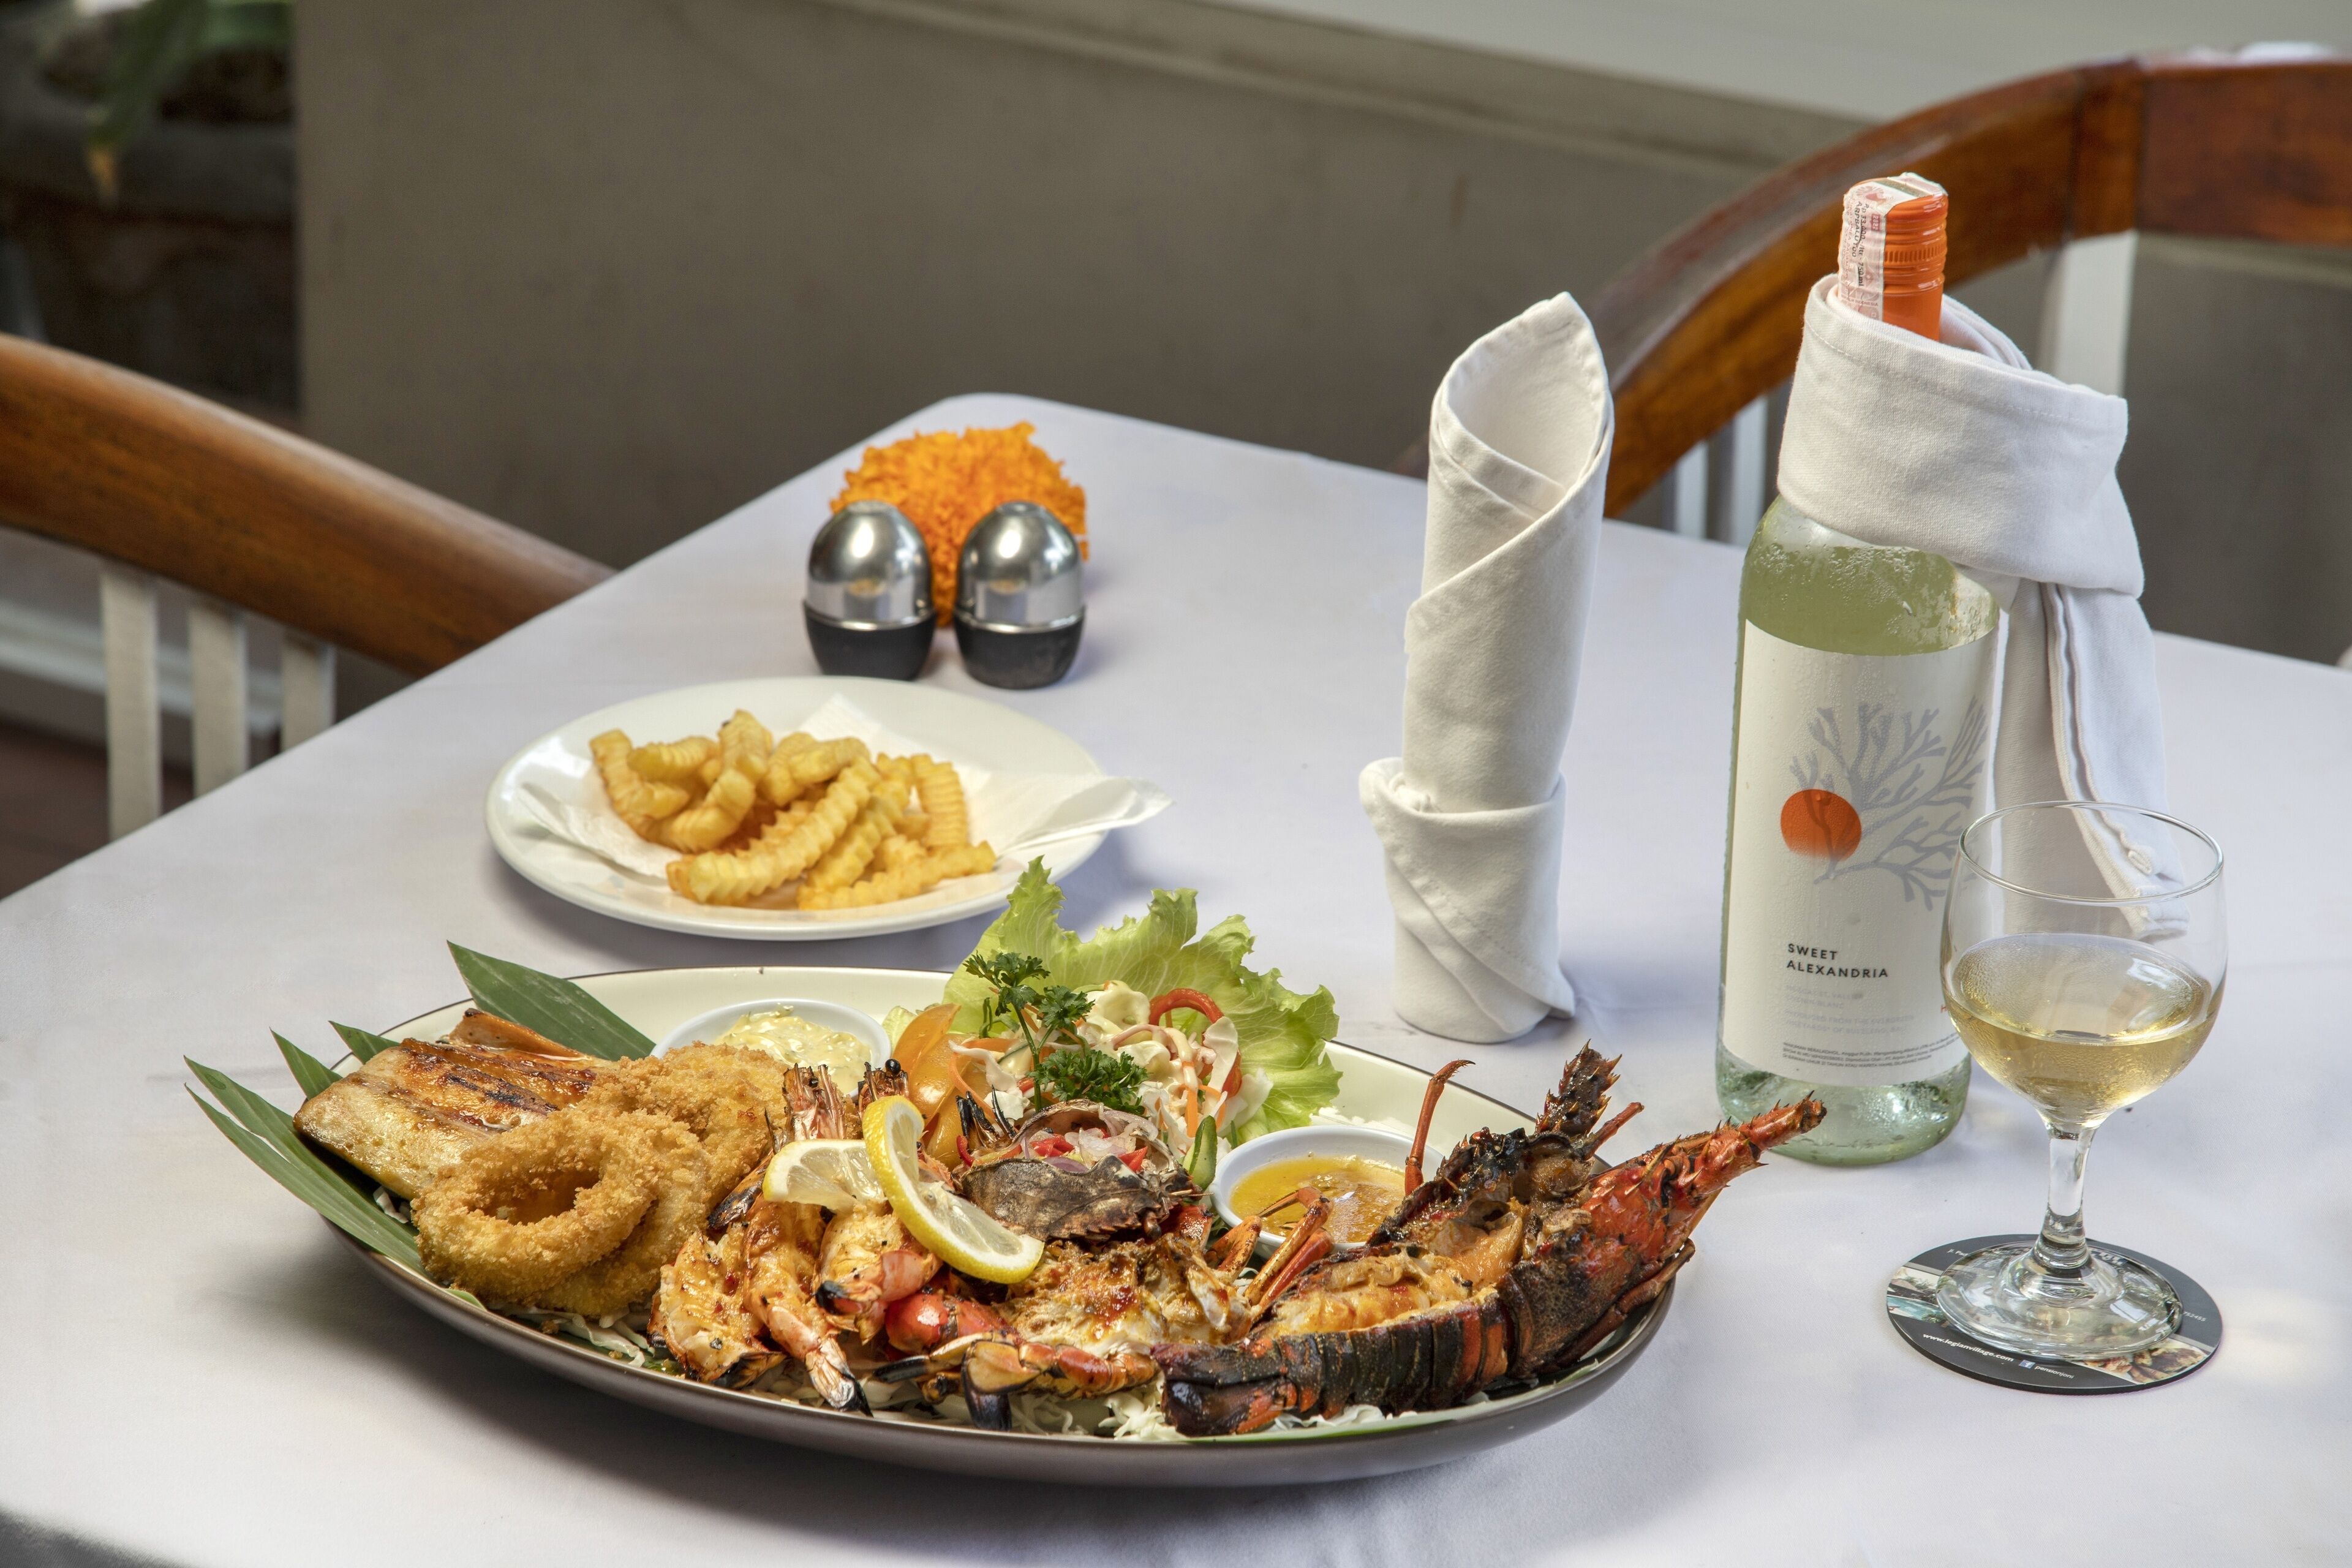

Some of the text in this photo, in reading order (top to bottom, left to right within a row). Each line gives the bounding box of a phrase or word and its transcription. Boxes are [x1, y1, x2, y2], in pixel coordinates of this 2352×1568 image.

[1788, 944, 1838, 960] SWEET
[1787, 960, 1888, 978] ALEXANDRIA
[1923, 1333, 2014, 1362] www.legianvillage.com
